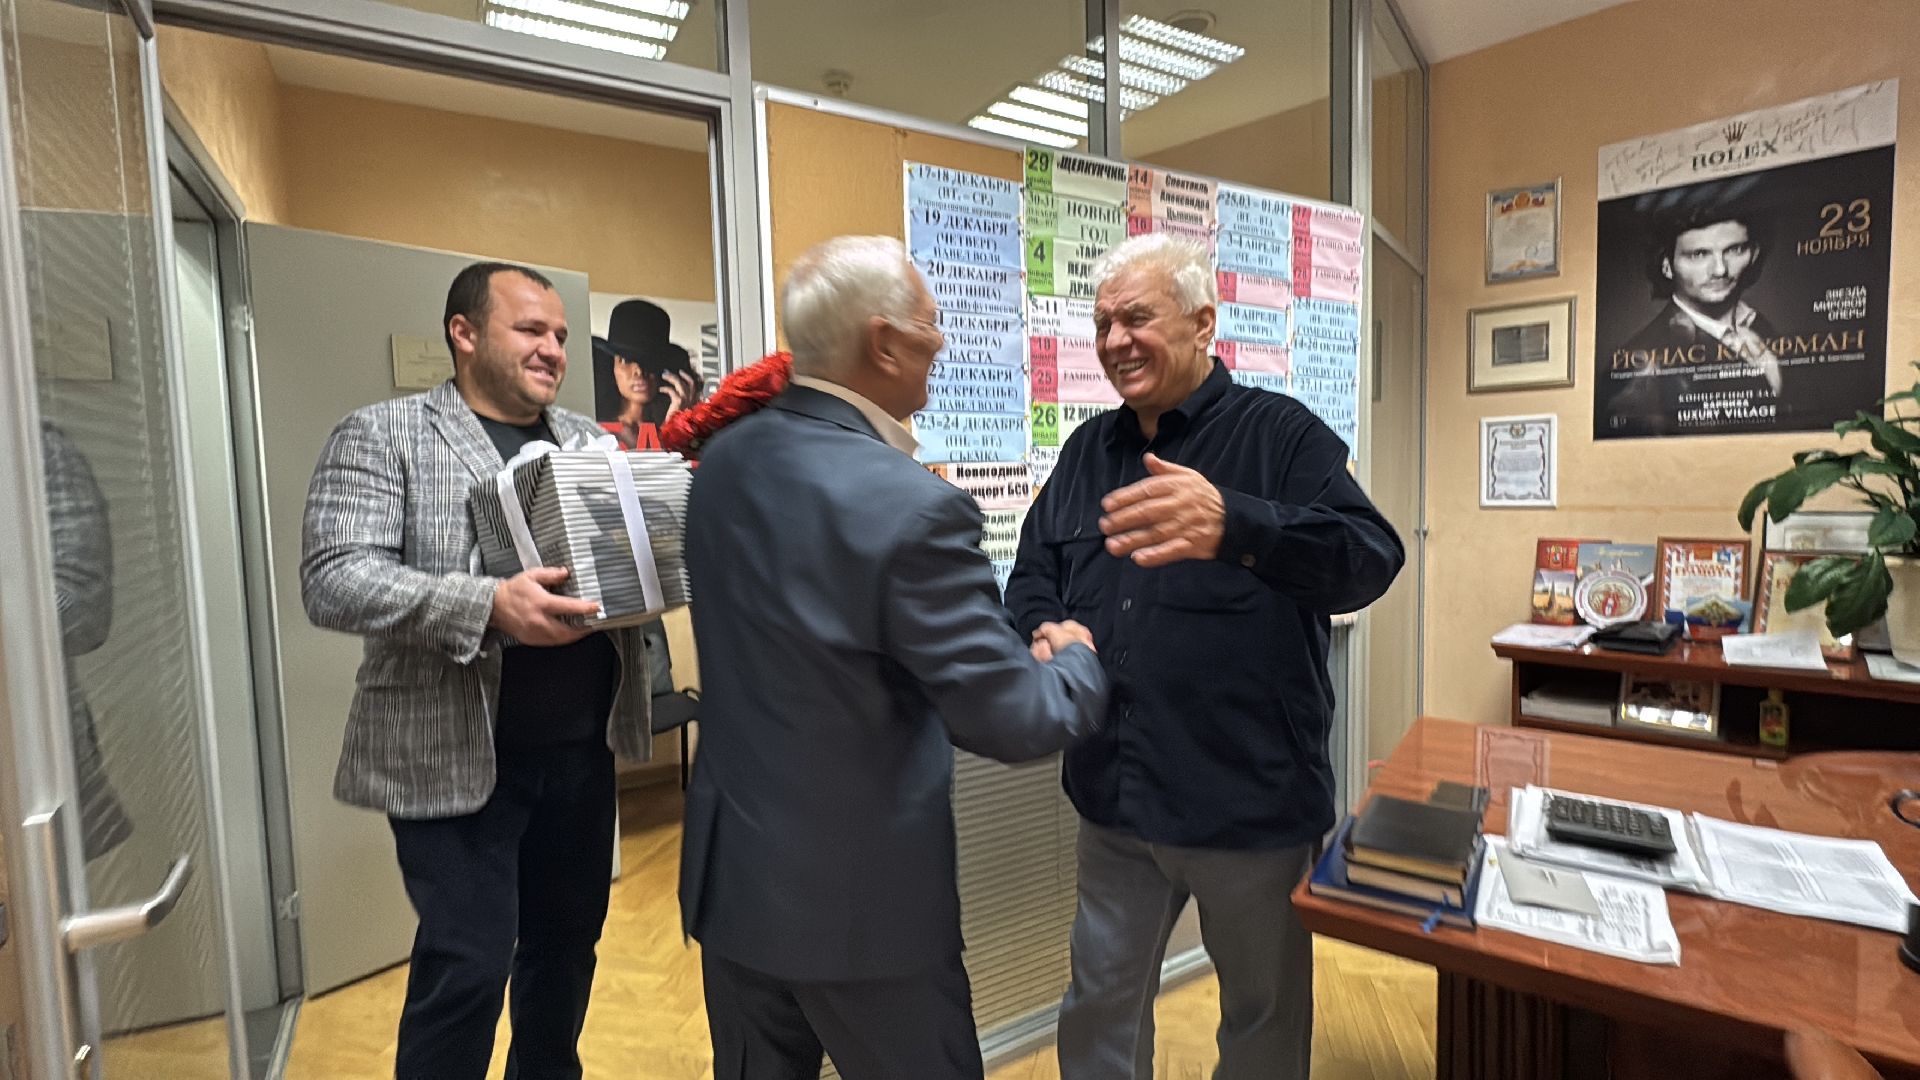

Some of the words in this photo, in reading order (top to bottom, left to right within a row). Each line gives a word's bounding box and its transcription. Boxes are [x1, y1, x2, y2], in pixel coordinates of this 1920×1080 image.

[1028, 150, 1049, 172] 29
[1692, 141, 1778, 172] ROLEX
[919, 164, 949, 180] 17-18
[952, 170, 1011, 194] ДЕКАБРЯ
[1135, 169, 1148, 186] 14
[924, 208, 941, 224] 19
[944, 214, 1008, 236] ДЕКАБРЯ
[1067, 201, 1121, 225] НОВЫЙ
[1819, 199, 1871, 238] 23
[936, 232, 997, 252] (ЧЕТВЕРГ)
[1080, 224, 1109, 246] ГОД
[1797, 232, 1870, 256] НОЯБРЯ
[1033, 240, 1046, 263] 4
[927, 260, 945, 277] 20
[948, 265, 1007, 284] ДЕКАБРЯ
[1826, 285, 1867, 301] ЗВЕЗДА
[1031, 299, 1057, 314] 5-11
[1813, 296, 1867, 313] МИРОВОЙ
[1828, 307, 1867, 321] ОПЕРЫ
[949, 316, 1008, 333] ДЕКАБРЯ
[1229, 306, 1240, 319] 10
[1243, 308, 1277, 324] АПРЕЛЯ
[943, 332, 1001, 350] СУББОТА)
[1611, 343, 1707, 370] ЙОНАС
[1717, 328, 1866, 362] КАУФМАН
[949, 349, 993, 364] БАСТА
[929, 362, 945, 380] 22
[949, 366, 1012, 383] ДЕКАБРЯ
[1038, 370, 1052, 385] 25
[927, 383, 1018, 400] ВОСКРЕСЕНЬЕ)
[918, 413, 959, 431] 23-24
[962, 417, 1024, 433] ДЕКАБРЯ
[1033, 406, 1057, 428] 26
[1063, 406, 1076, 421] 12
[1677, 409, 1720, 423] LUXURY
[1725, 405, 1777, 420] VILLAGE
[956, 465, 1027, 480] Новогодний
[963, 484, 1004, 500] онцерт
[1007, 482, 1029, 497] БСО
